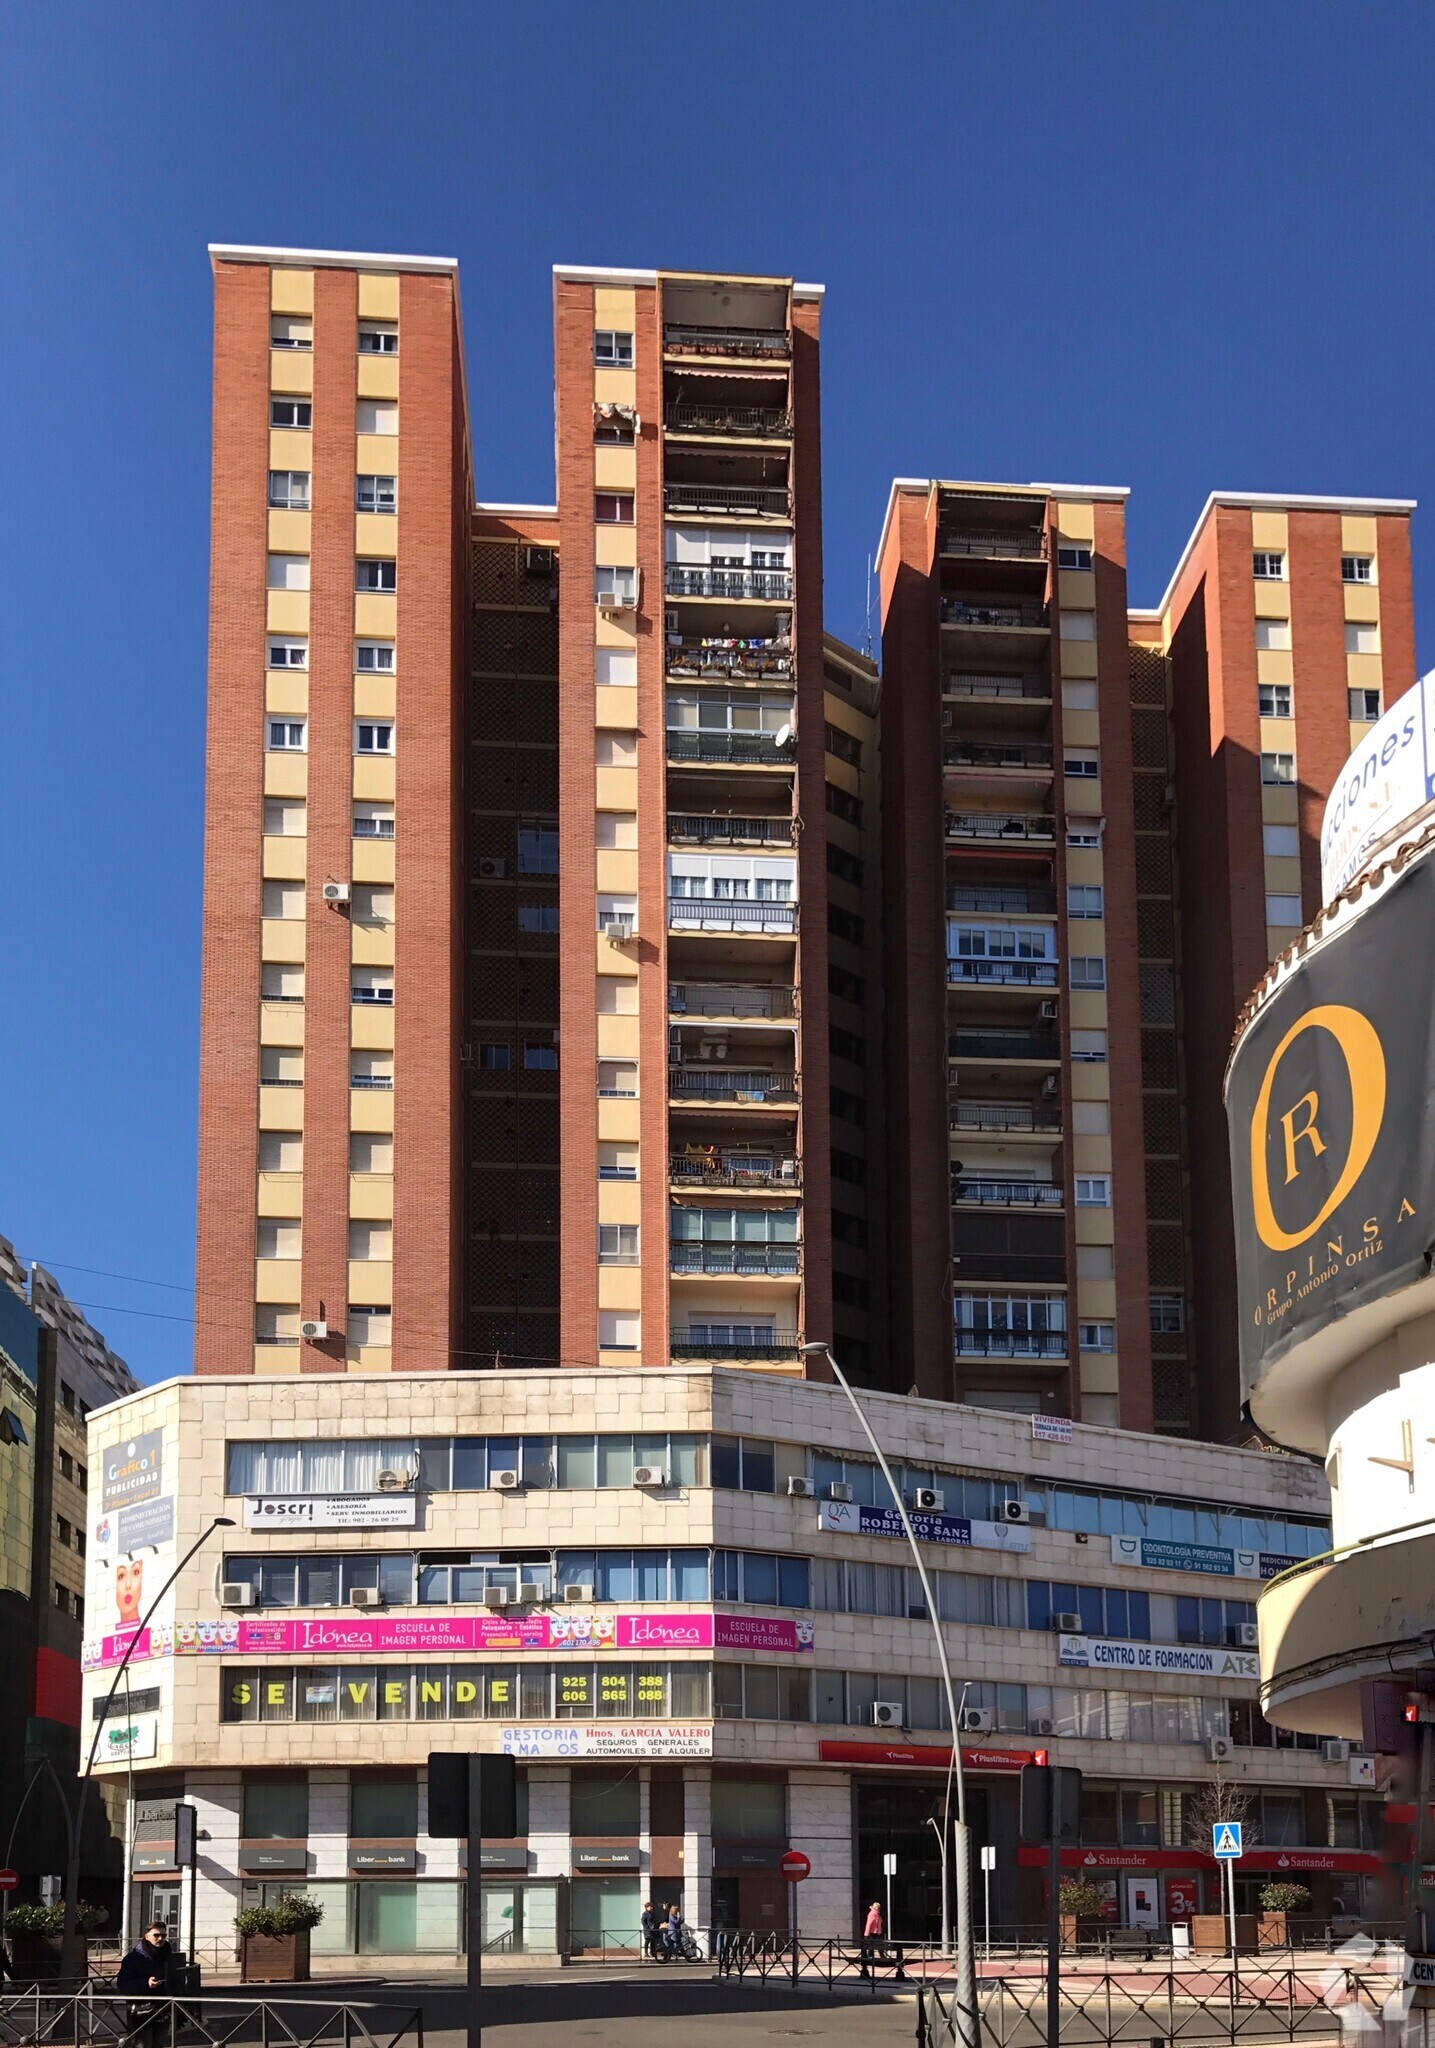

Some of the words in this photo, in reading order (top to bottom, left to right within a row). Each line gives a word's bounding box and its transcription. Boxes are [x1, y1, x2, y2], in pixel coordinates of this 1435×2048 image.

[1254, 1198, 1416, 1326] ORPINSA
[1266, 1298, 1292, 1325] Grupo
[1296, 1263, 1339, 1301] Antonio
[1345, 1239, 1383, 1267] Ortiz
[1034, 1415, 1071, 1426] VIVIENDA
[106, 1471, 158, 1497] PUBLICIDAD
[884, 1509, 942, 1525] Getoría
[933, 1523, 969, 1538] SANZ
[902, 1532, 930, 1541] FCAL
[936, 1536, 971, 1545] LABORAL
[1143, 1543, 1191, 1556] ODONTOLOGÍA
[1192, 1549, 1232, 1561] PREVENTIVA
[1261, 1556, 1292, 1565] MEDICINA
[395, 1623, 434, 1633] ESCUELA
[439, 1623, 450, 1632] DE
[629, 1618, 699, 1644] Idónea
[730, 1621, 765, 1633] ESCUELA
[769, 1624, 779, 1633] DE
[302, 1622, 372, 1648] Idónea
[381, 1635, 417, 1645] IMAGEN
[420, 1634, 467, 1644] PERSONAL
[717, 1632, 750, 1643] IMAGEN
[753, 1636, 793, 1647] PERSONAL
[1094, 1645, 1135, 1665] CENTRO
[1138, 1649, 1151, 1666] DE
[1155, 1651, 1213, 1671] FORMACIÓN
[562, 1677, 587, 1687] 925
[601, 1676, 626, 1686] 804
[638, 1676, 663, 1686] 388
[348, 1681, 509, 1704] VENDE
[562, 1691, 587, 1701] 606
[602, 1690, 627, 1700] 865
[638, 1690, 663, 1700] 088
[503, 1729, 578, 1740] GESTORIA
[586, 1729, 616, 1738] Hnos.
[621, 1729, 663, 1738] GARCIA
[668, 1729, 711, 1738] VALERO
[586, 1747, 646, 1755] AUTOMOVILES
[651, 1747, 663, 1755] DE
[670, 1746, 711, 1755] ALQUILER
[979, 1755, 1009, 1764] PlusUltra
[1099, 1854, 1147, 1865] Santander
[1291, 1856, 1335, 1868] Santander
